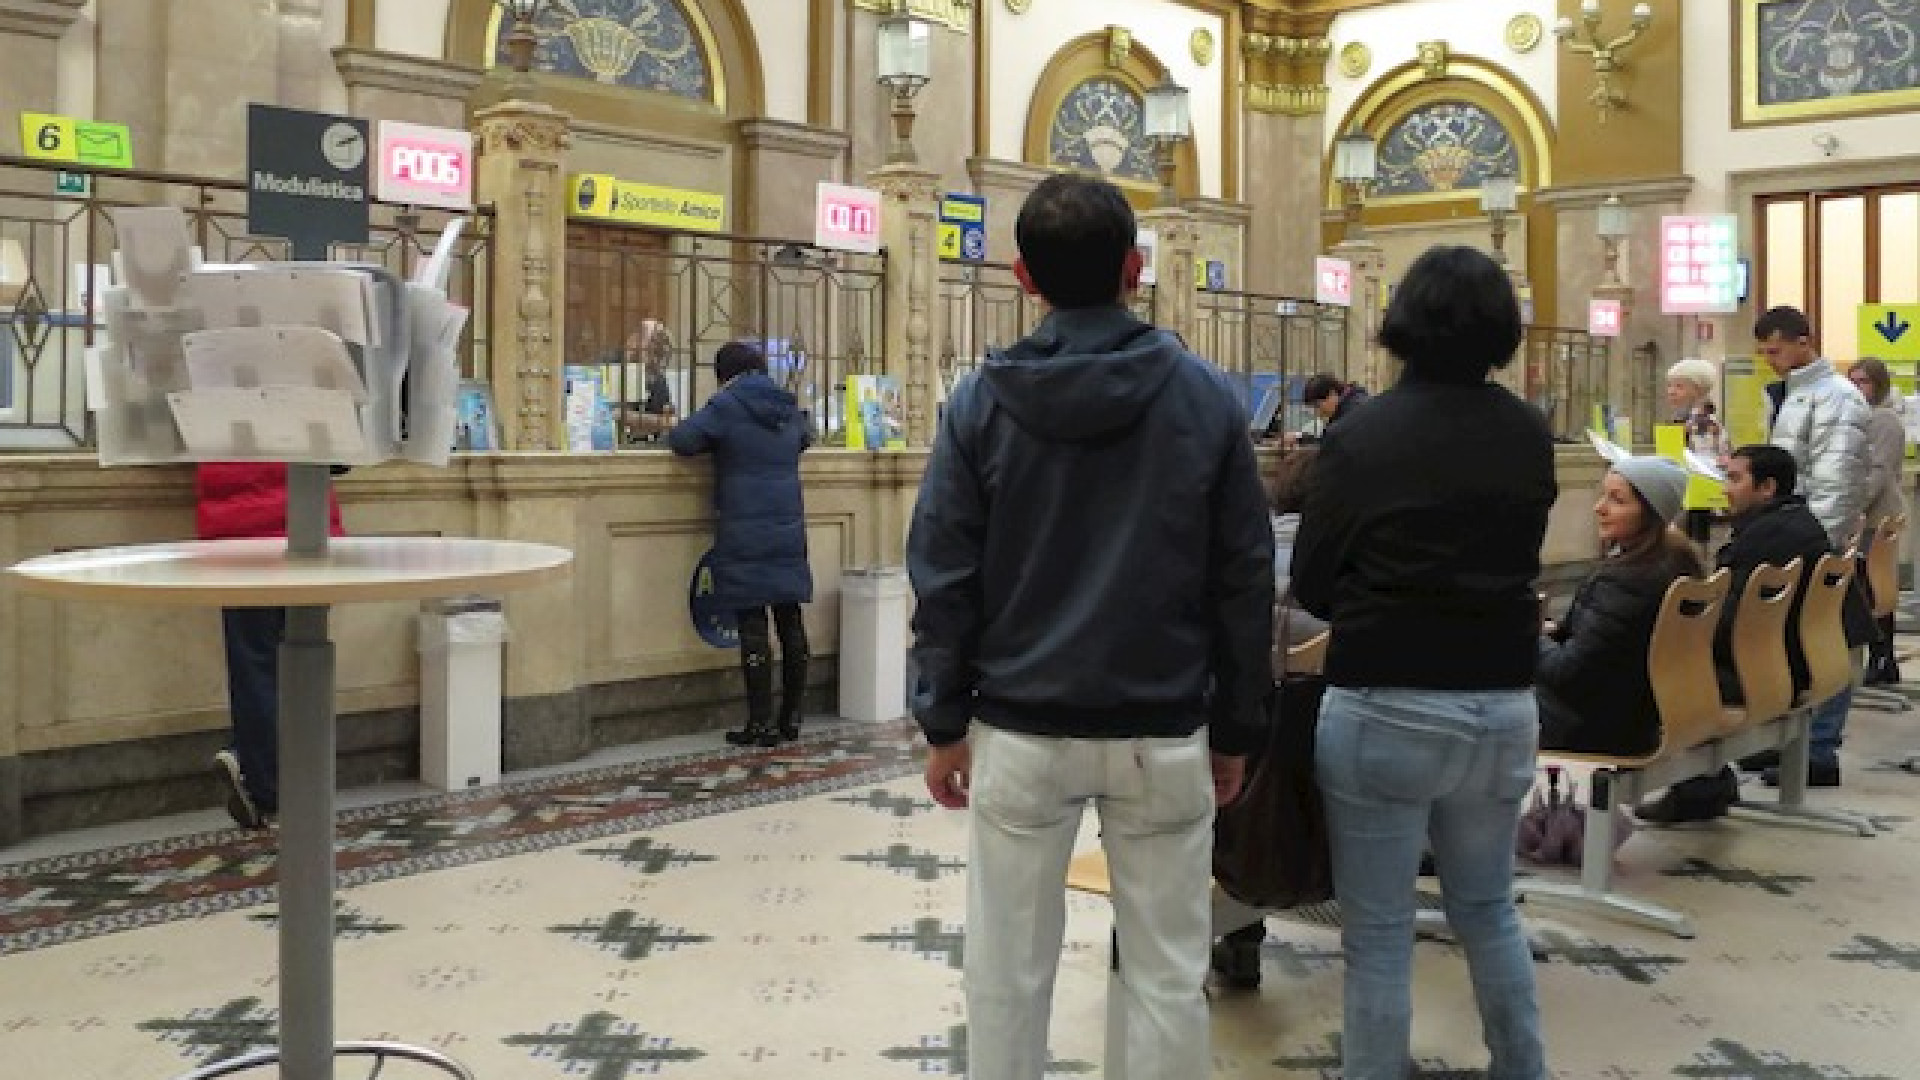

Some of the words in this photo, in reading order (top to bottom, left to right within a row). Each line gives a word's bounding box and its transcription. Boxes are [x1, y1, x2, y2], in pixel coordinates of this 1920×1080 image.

[38, 123, 61, 151] 6
[254, 170, 364, 201] Modulistica
[942, 229, 956, 250] 4
